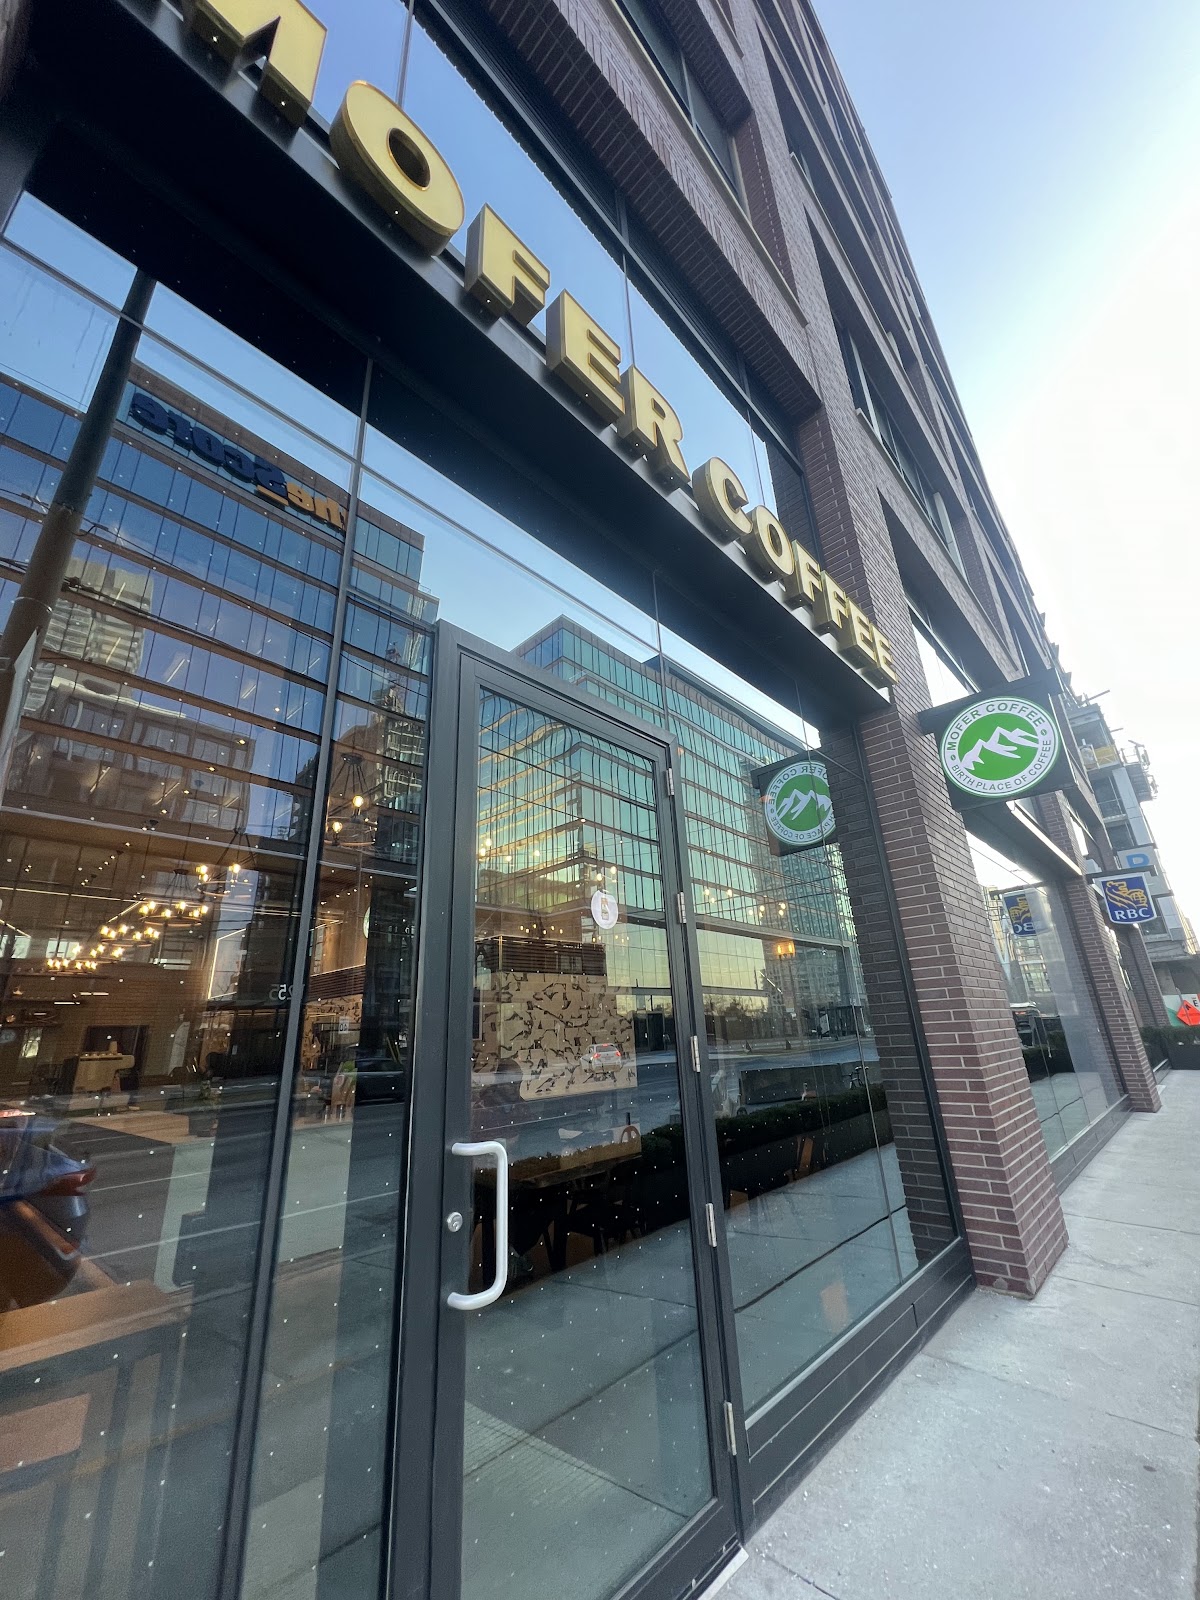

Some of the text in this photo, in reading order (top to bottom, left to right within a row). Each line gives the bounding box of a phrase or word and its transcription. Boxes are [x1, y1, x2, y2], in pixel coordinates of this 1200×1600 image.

[694, 456, 898, 684] COFFEE
[946, 702, 1046, 751] MOFER COFFEE
[951, 739, 1051, 791] BIRTH PLACE OF COFFEE
[1114, 907, 1150, 920] RBC
